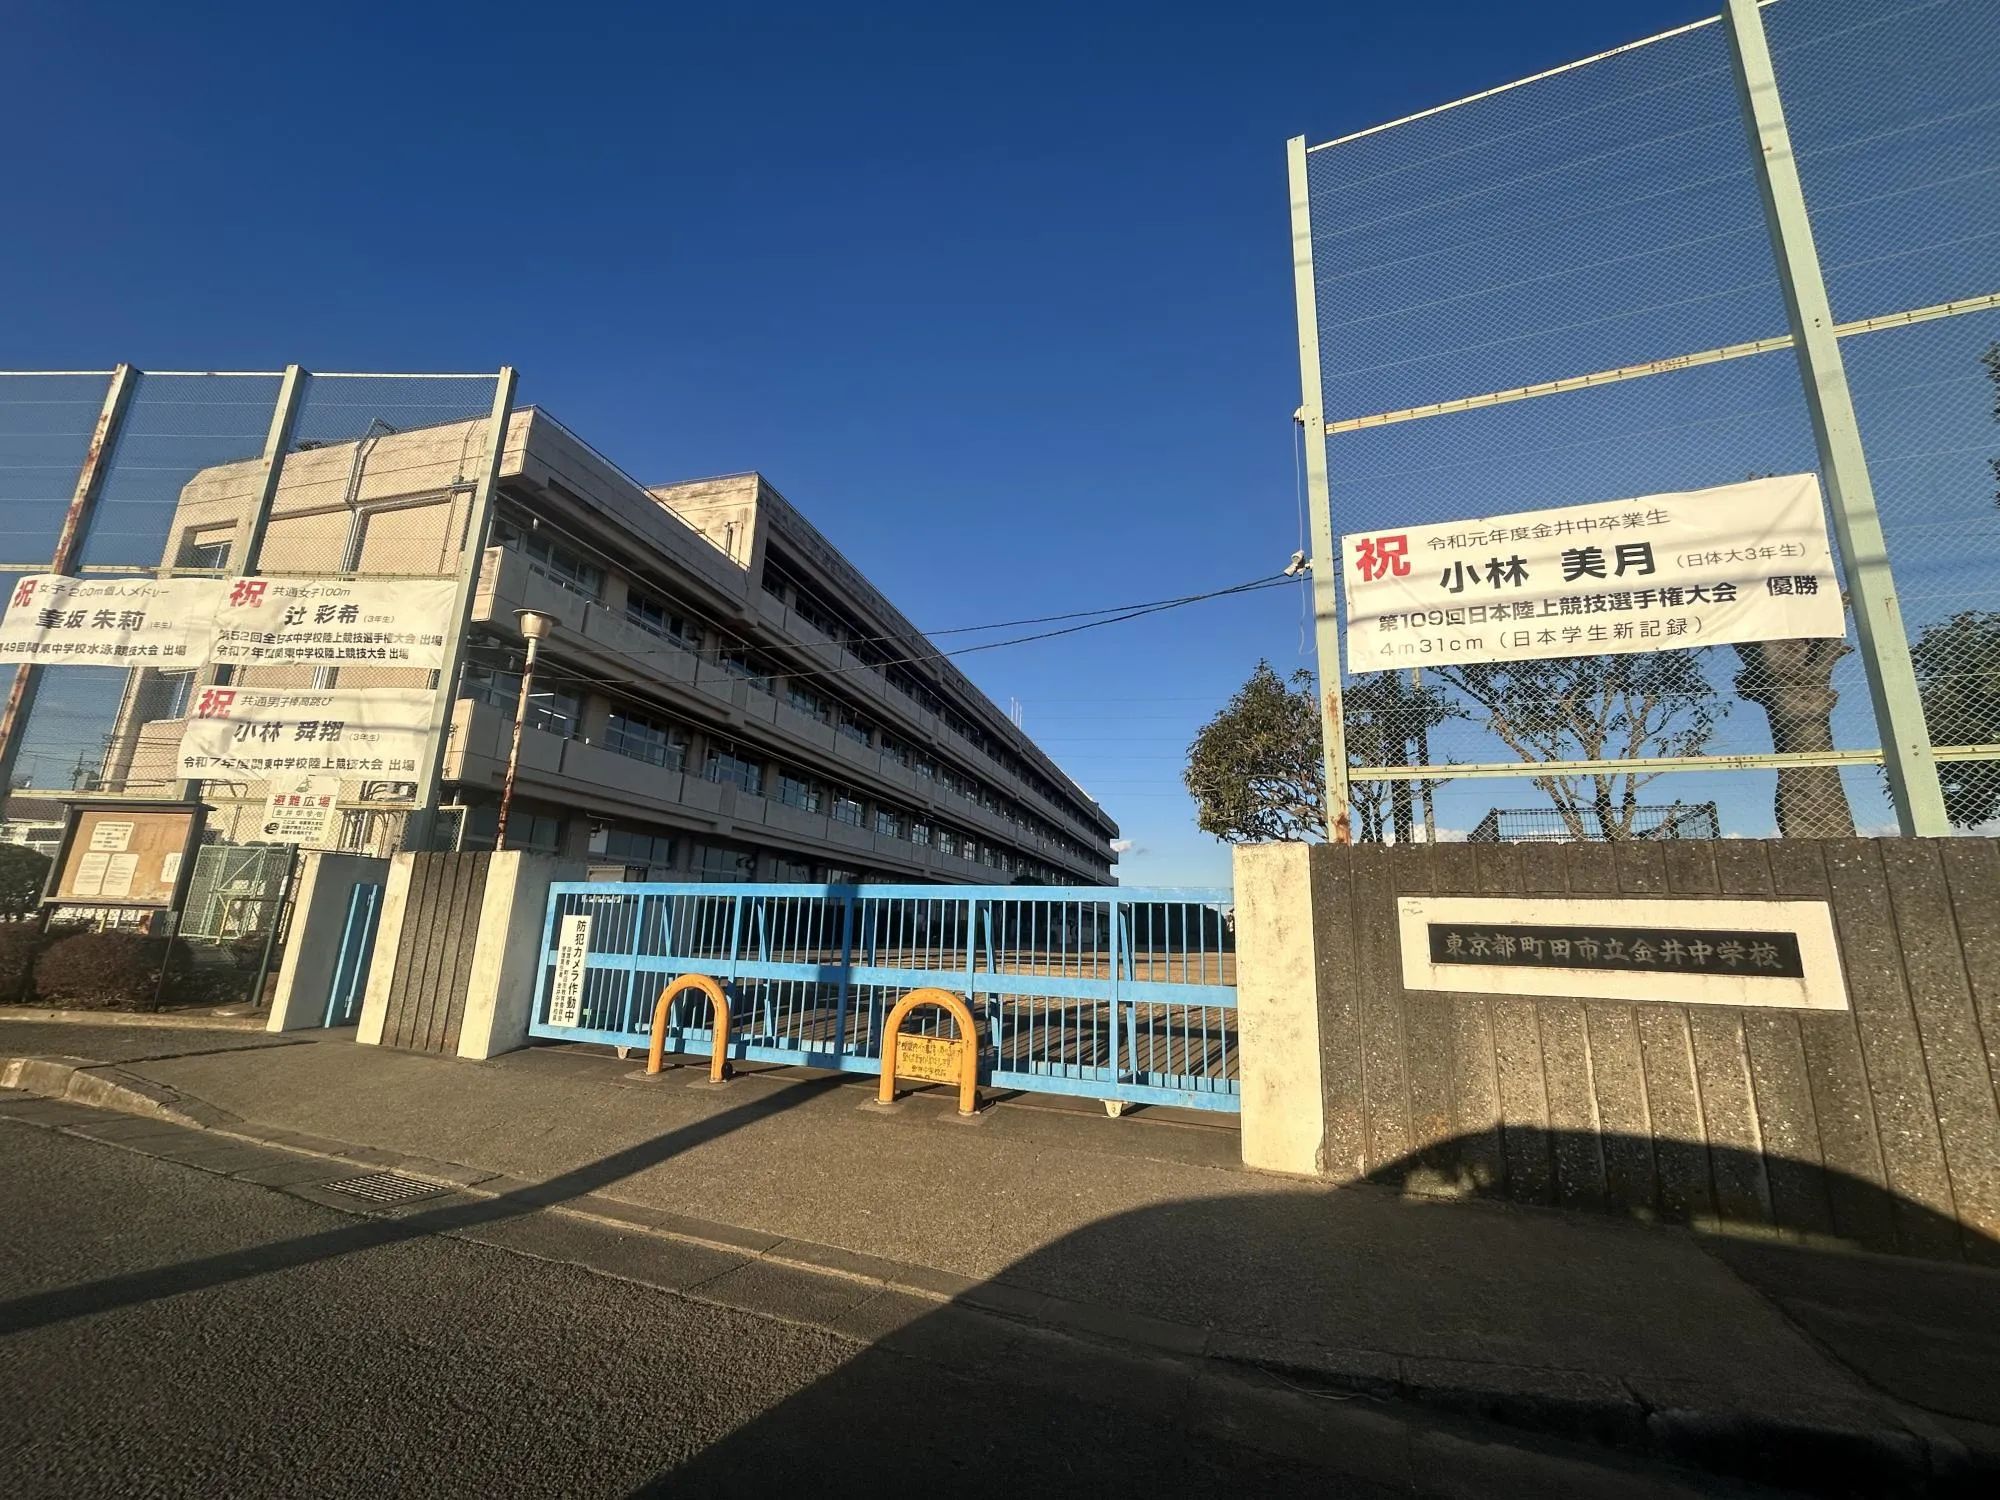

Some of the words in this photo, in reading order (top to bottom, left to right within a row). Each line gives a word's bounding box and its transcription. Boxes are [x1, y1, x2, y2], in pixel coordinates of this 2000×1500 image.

[1426, 508, 1671, 551] 令和元年度金井中卒業生
[1356, 534, 1411, 583] 祝
[1439, 555, 1531, 594] 小林
[1561, 541, 1658, 582] 美月
[12, 579, 38, 608] 祝
[229, 580, 269, 608] 祝
[272, 586, 351, 599] 共通女子100m
[1378, 581, 1738, 633] 第109回日本陸上競技選手権大会
[1766, 575, 1819, 597] 優勝
[284, 605, 308, 625] 辻
[314, 604, 360, 625] 彩希
[0, 641, 160, 657] 49回関東中学校水泳競技大会
[389, 648, 410, 660] 出場
[420, 633, 443, 647] 出場
[198, 690, 237, 719] 祝
[233, 720, 283, 744] 小林
[388, 759, 415, 772] 出場
[272, 795, 331, 808] 避難広場
[1445, 931, 1783, 970] 東京都町田市立金井中学校
[564, 920, 587, 1023] 防犯カメラ作動中
